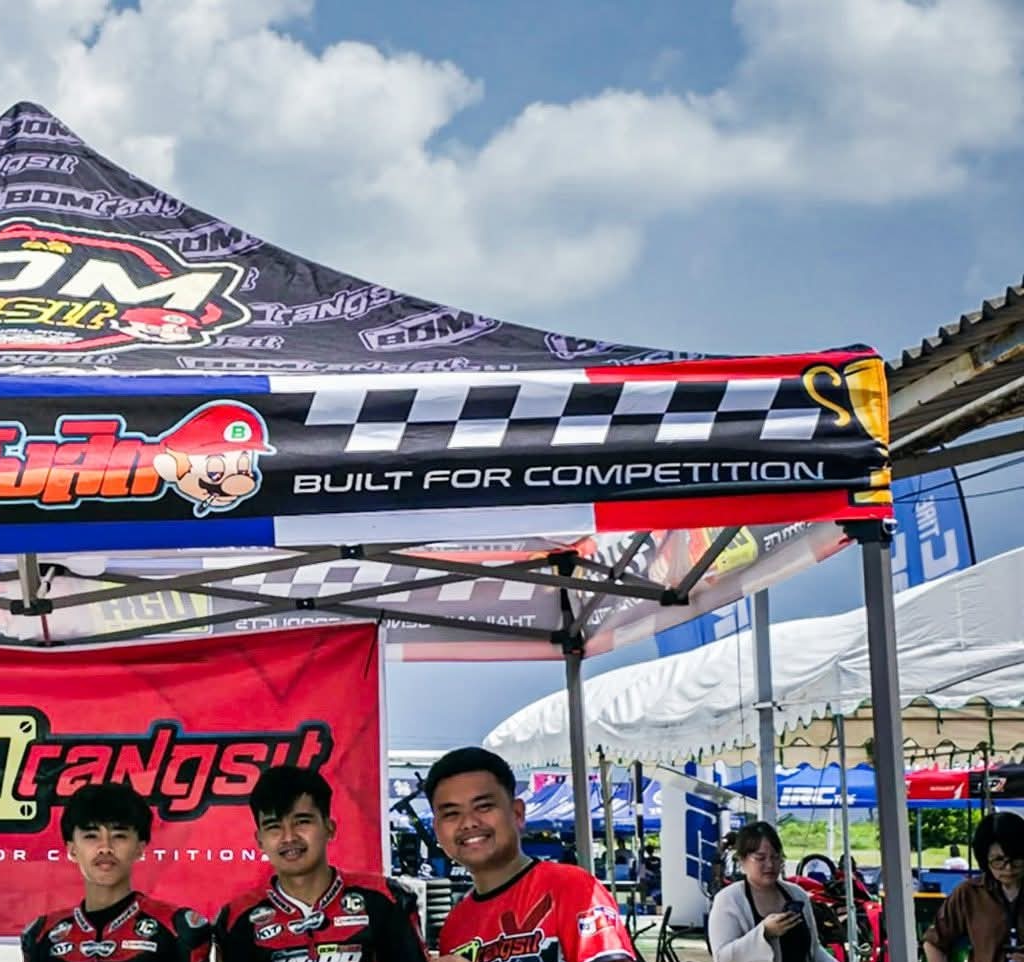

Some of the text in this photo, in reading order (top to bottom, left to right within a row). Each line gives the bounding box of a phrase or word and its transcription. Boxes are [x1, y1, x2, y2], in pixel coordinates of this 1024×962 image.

[5, 189, 93, 217] BOM
[377, 312, 476, 346] BOM
[231, 425, 247, 438] B
[293, 460, 825, 495] BUILT FOR COMPETITION
[779, 786, 836, 806] IRC
[47, 848, 255, 861] CTITION
